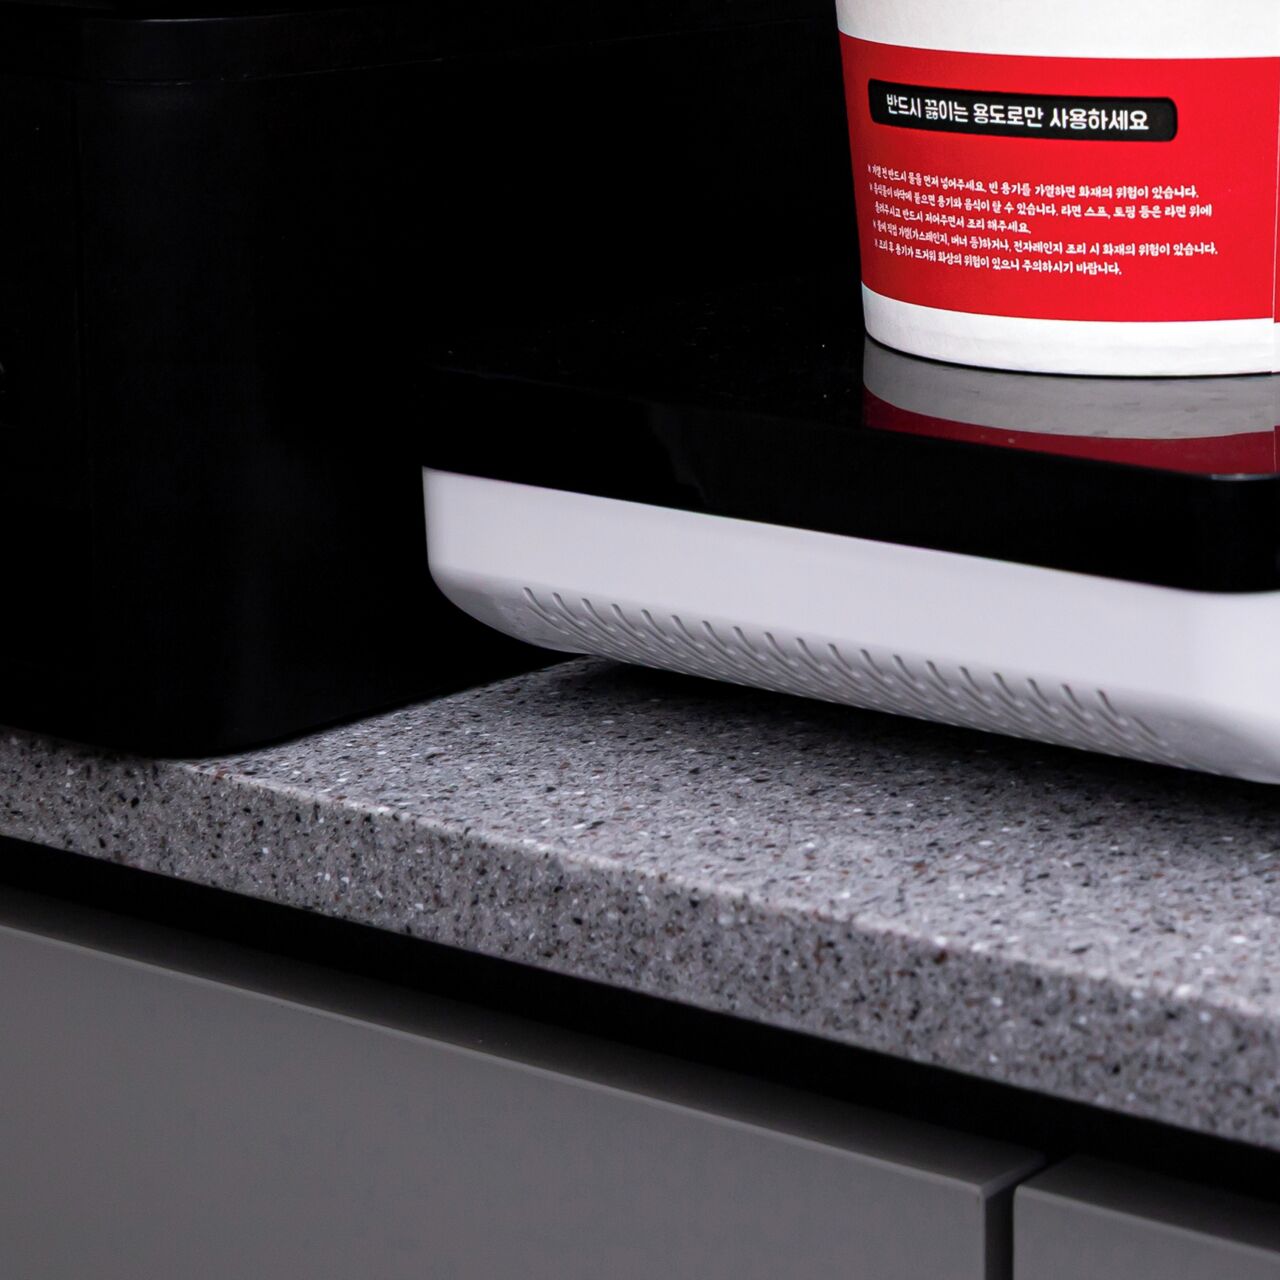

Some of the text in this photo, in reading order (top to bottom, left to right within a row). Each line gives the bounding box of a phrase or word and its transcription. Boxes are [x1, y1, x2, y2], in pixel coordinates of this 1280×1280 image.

[886, 93, 1150, 131] 반드시 끓이는 용도로만 사용하세요
[888, 169, 907, 182] 반드시
[908, 172, 922, 187] 물을
[923, 175, 939, 189] 먼저
[989, 181, 999, 195] 빈
[1000, 181, 1031, 197] 용기를
[1035, 184, 1076, 199] 가열하면
[1078, 185, 1113, 199] 화재의
[1115, 185, 1149, 200] 위험이
[1151, 185, 1200, 200] 있습니다.
[902, 207, 924, 223] 반드시
[925, 211, 965, 228] 저어주면서
[966, 217, 985, 231] 조리
[937, 194, 963, 210] 용기와
[964, 197, 990, 213] 음식이
[1003, 201, 1015, 214] 수
[1016, 202, 1059, 217] 있습니다.
[1061, 204, 1082, 218] 라면
[1113, 205, 1136, 219] 토핑
[1138, 204, 1162, 219] 등은
[1164, 204, 1187, 218] 라면
[1188, 203, 1213, 217] 위에
[951, 233, 968, 248] 버너
[1013, 240, 1063, 256] 전자레인지
[1065, 242, 1086, 255] 조리
[1089, 242, 1100, 256] 시
[1102, 243, 1136, 257] 화재의
[1138, 243, 1170, 257] 위험이
[1173, 241, 1218, 256] 있습니다.
[895, 244, 914, 258] 용기가
[915, 247, 937, 262] 뜨거워
[937, 250, 963, 266] 화상의
[964, 254, 990, 269] 위험이
[991, 257, 1020, 271] 있으니
[1021, 260, 1074, 274] 주의하시기
[1075, 261, 1123, 276] 바랍니다.
